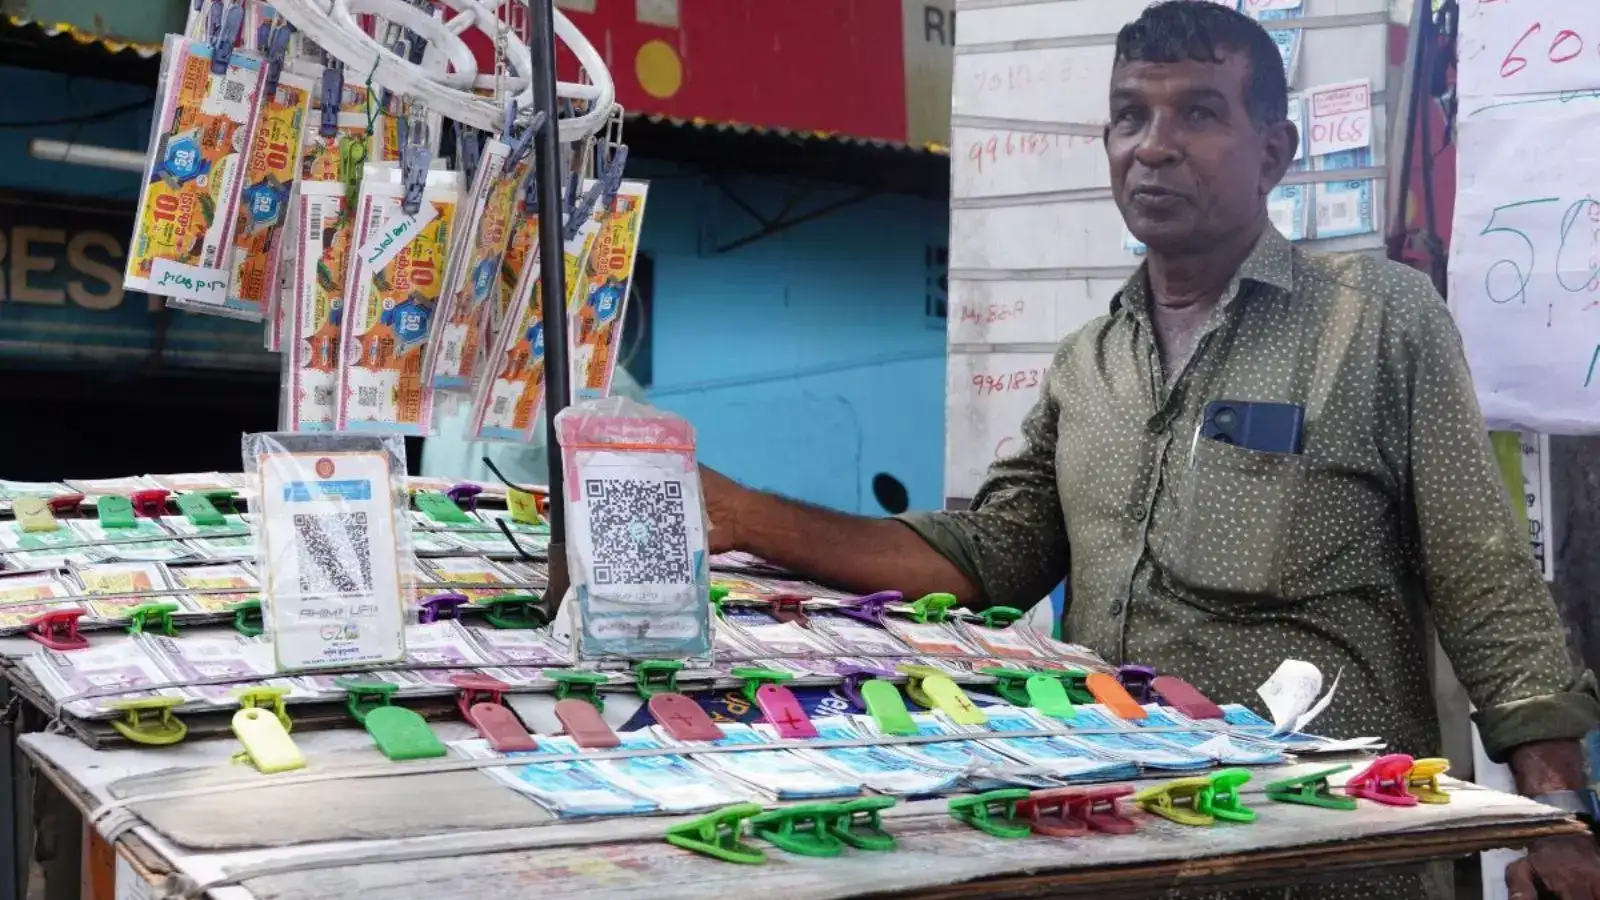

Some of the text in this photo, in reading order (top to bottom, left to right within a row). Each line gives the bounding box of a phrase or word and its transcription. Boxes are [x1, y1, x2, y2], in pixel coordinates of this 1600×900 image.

[924, 6, 955, 47] R
[1500, 22, 1600, 77] 60
[1311, 116, 1364, 143] 0168
[0, 226, 161, 312] ES
